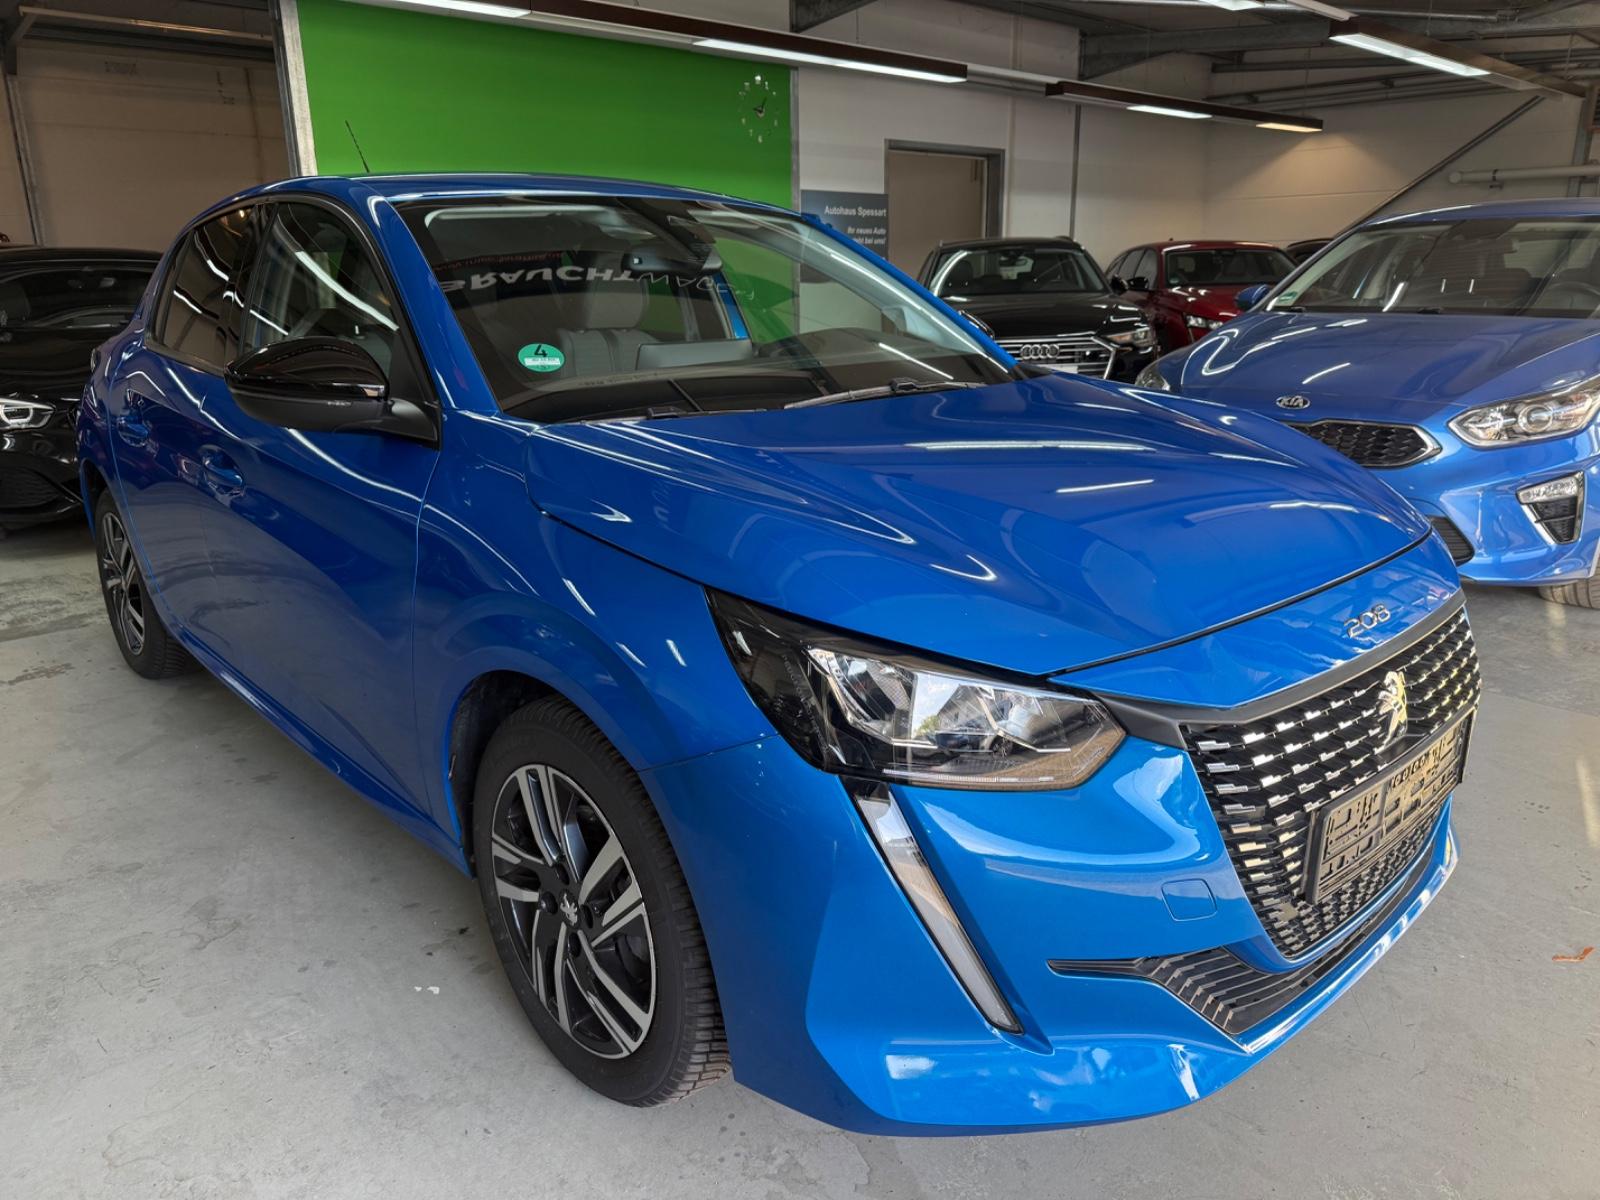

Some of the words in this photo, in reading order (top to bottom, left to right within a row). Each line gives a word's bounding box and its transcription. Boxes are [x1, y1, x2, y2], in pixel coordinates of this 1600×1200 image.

[824, 205, 857, 216] Autohaus
[857, 206, 887, 218] Spessart
[873, 227, 886, 235] Auto
[534, 344, 548, 357] 4
[1279, 396, 1304, 408] KIA
[1343, 604, 1391, 638] 208
